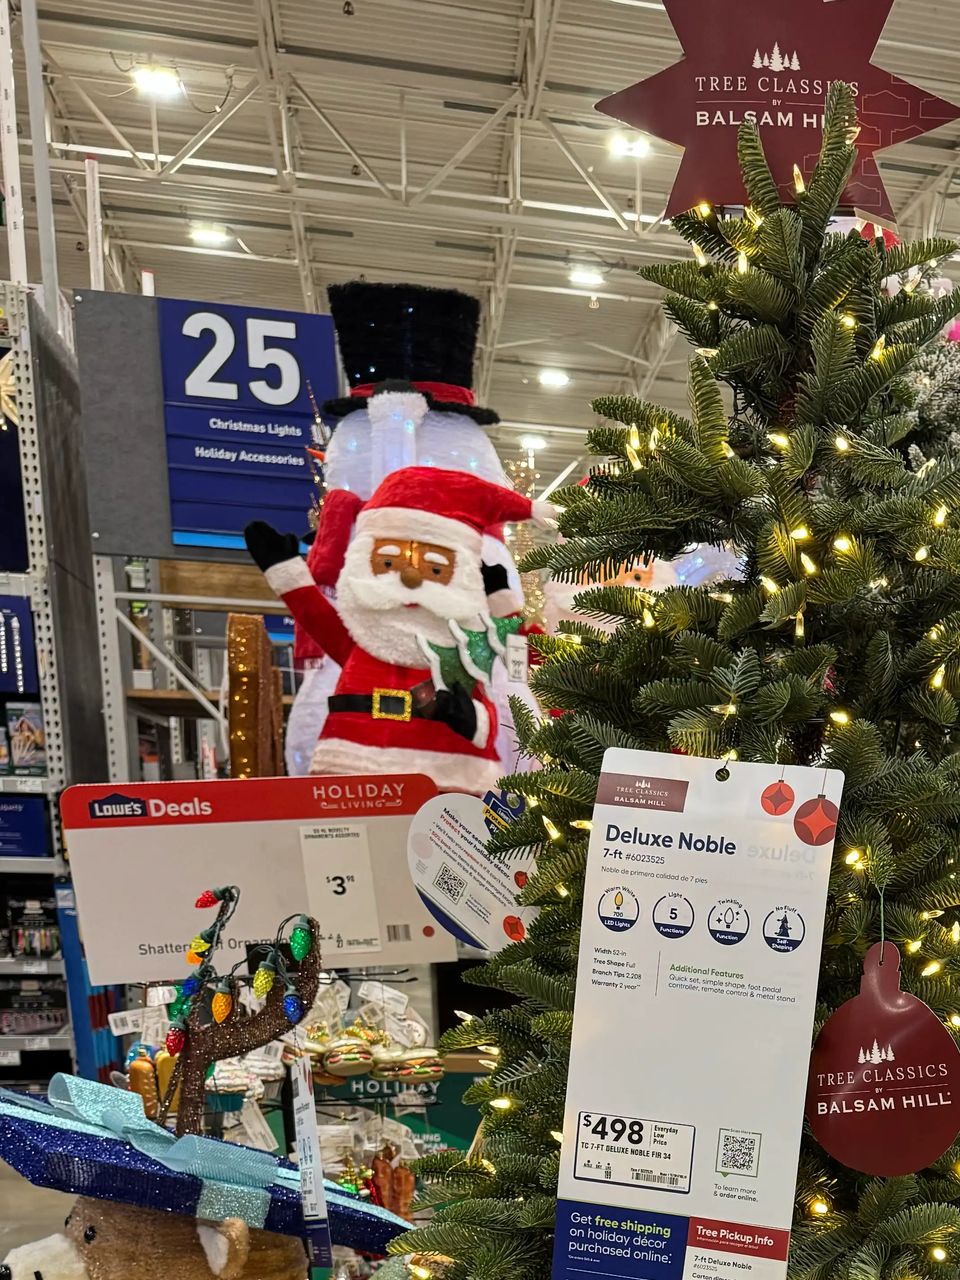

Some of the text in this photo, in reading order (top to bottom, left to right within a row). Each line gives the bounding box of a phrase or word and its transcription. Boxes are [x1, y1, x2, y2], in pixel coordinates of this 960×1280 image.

[695, 76, 859, 97] TREE CLASSIS
[696, 111, 793, 127] BALSAM
[182, 312, 301, 405] 25
[209, 418, 302, 437] Christmas Lights
[195, 447, 305, 466] Holiday Accessories
[313, 783, 405, 799] HOLIDAY
[635, 788, 668, 797] CLASSICS
[94, 798, 213, 817] LOWE'S Deals
[341, 799, 384, 809] LIVING
[614, 796, 646, 805] BALSAM
[605, 824, 737, 855] Deluxe Noble
[603, 848, 665, 864] 7-ft #6023525
[601, 866, 620, 875] Noble
[621, 868, 629, 876] de
[630, 870, 655, 879] primera
[655, 871, 680, 881] calidad
[694, 877, 708, 885] pies
[605, 885, 637, 898] Warm White
[669, 908, 678, 920] 5
[614, 920, 631, 928] Lights
[660, 927, 685, 935] Functions
[716, 933, 739, 941] Function
[594, 947, 627, 957] Width 52-in
[606, 959, 625, 968] Shape
[669, 964, 744, 979] Additional Features
[592, 969, 612, 978] Branch
[613, 970, 625, 979] Tips
[591, 979, 618, 989] Warranty
[669, 974, 782, 993] Quick set, simple shape, foot pedal
[668, 982, 700, 992] controller,
[701, 986, 725, 995] remote
[726, 988, 748, 997] control
[756, 992, 776, 1000] metal
[776, 994, 796, 1003] stand
[817, 1063, 948, 1087] TREE CLASSICS
[817, 1093, 952, 1115] BALSAM HILL
[583, 1114, 679, 1145] $498 Everyday
[653, 1138, 668, 1146] Price
[590, 1143, 605, 1151] 7-FT
[605, 1145, 629, 1154] DELUXE
[630, 1148, 650, 1157] NOBLE
[651, 1151, 663, 1159] FIR
[663, 1152, 672, 1160] 34
[722, 1185, 740, 1193] learn
[740, 1187, 757, 1195] more
[737, 1194, 759, 1202] online.
[570, 1212, 671, 1238] Get free shipping
[569, 1228, 667, 1249] on holiday décor
[696, 1225, 718, 1238] Tree
[719, 1229, 753, 1244] Pickup
[754, 1235, 774, 1247] Info
[568, 1241, 631, 1258] purchased
[694, 1255, 753, 1270] 7-ft Deluxe Noble
